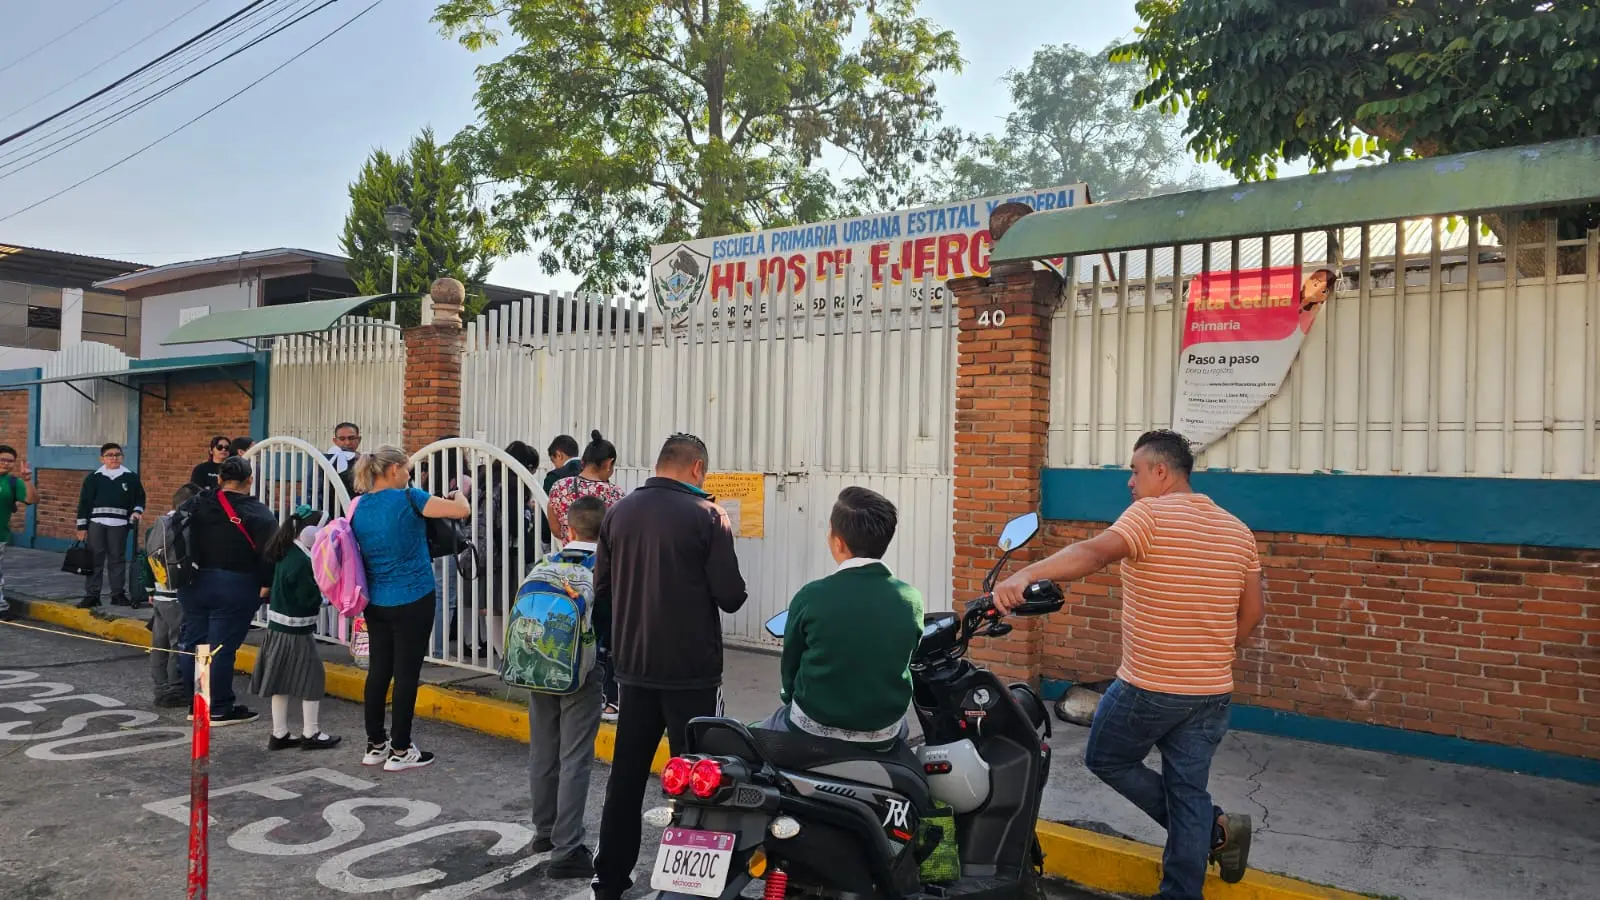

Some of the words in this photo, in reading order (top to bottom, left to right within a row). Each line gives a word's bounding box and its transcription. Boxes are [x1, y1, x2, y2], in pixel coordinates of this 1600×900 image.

[712, 234, 765, 260] ESCUELA
[771, 224, 838, 252] PRIMARIA
[843, 215, 901, 243] URBANA
[907, 203, 980, 234] ESTATAL
[711, 253, 807, 302] HIJOS
[1229, 291, 1292, 310] Cetina
[977, 309, 1006, 327] 40
[1191, 319, 1240, 332] Primaria
[1187, 353, 1216, 365] Paso
[1218, 355, 1226, 364] a
[1229, 354, 1260, 367] paso
[662, 848, 720, 879] L8K20C
